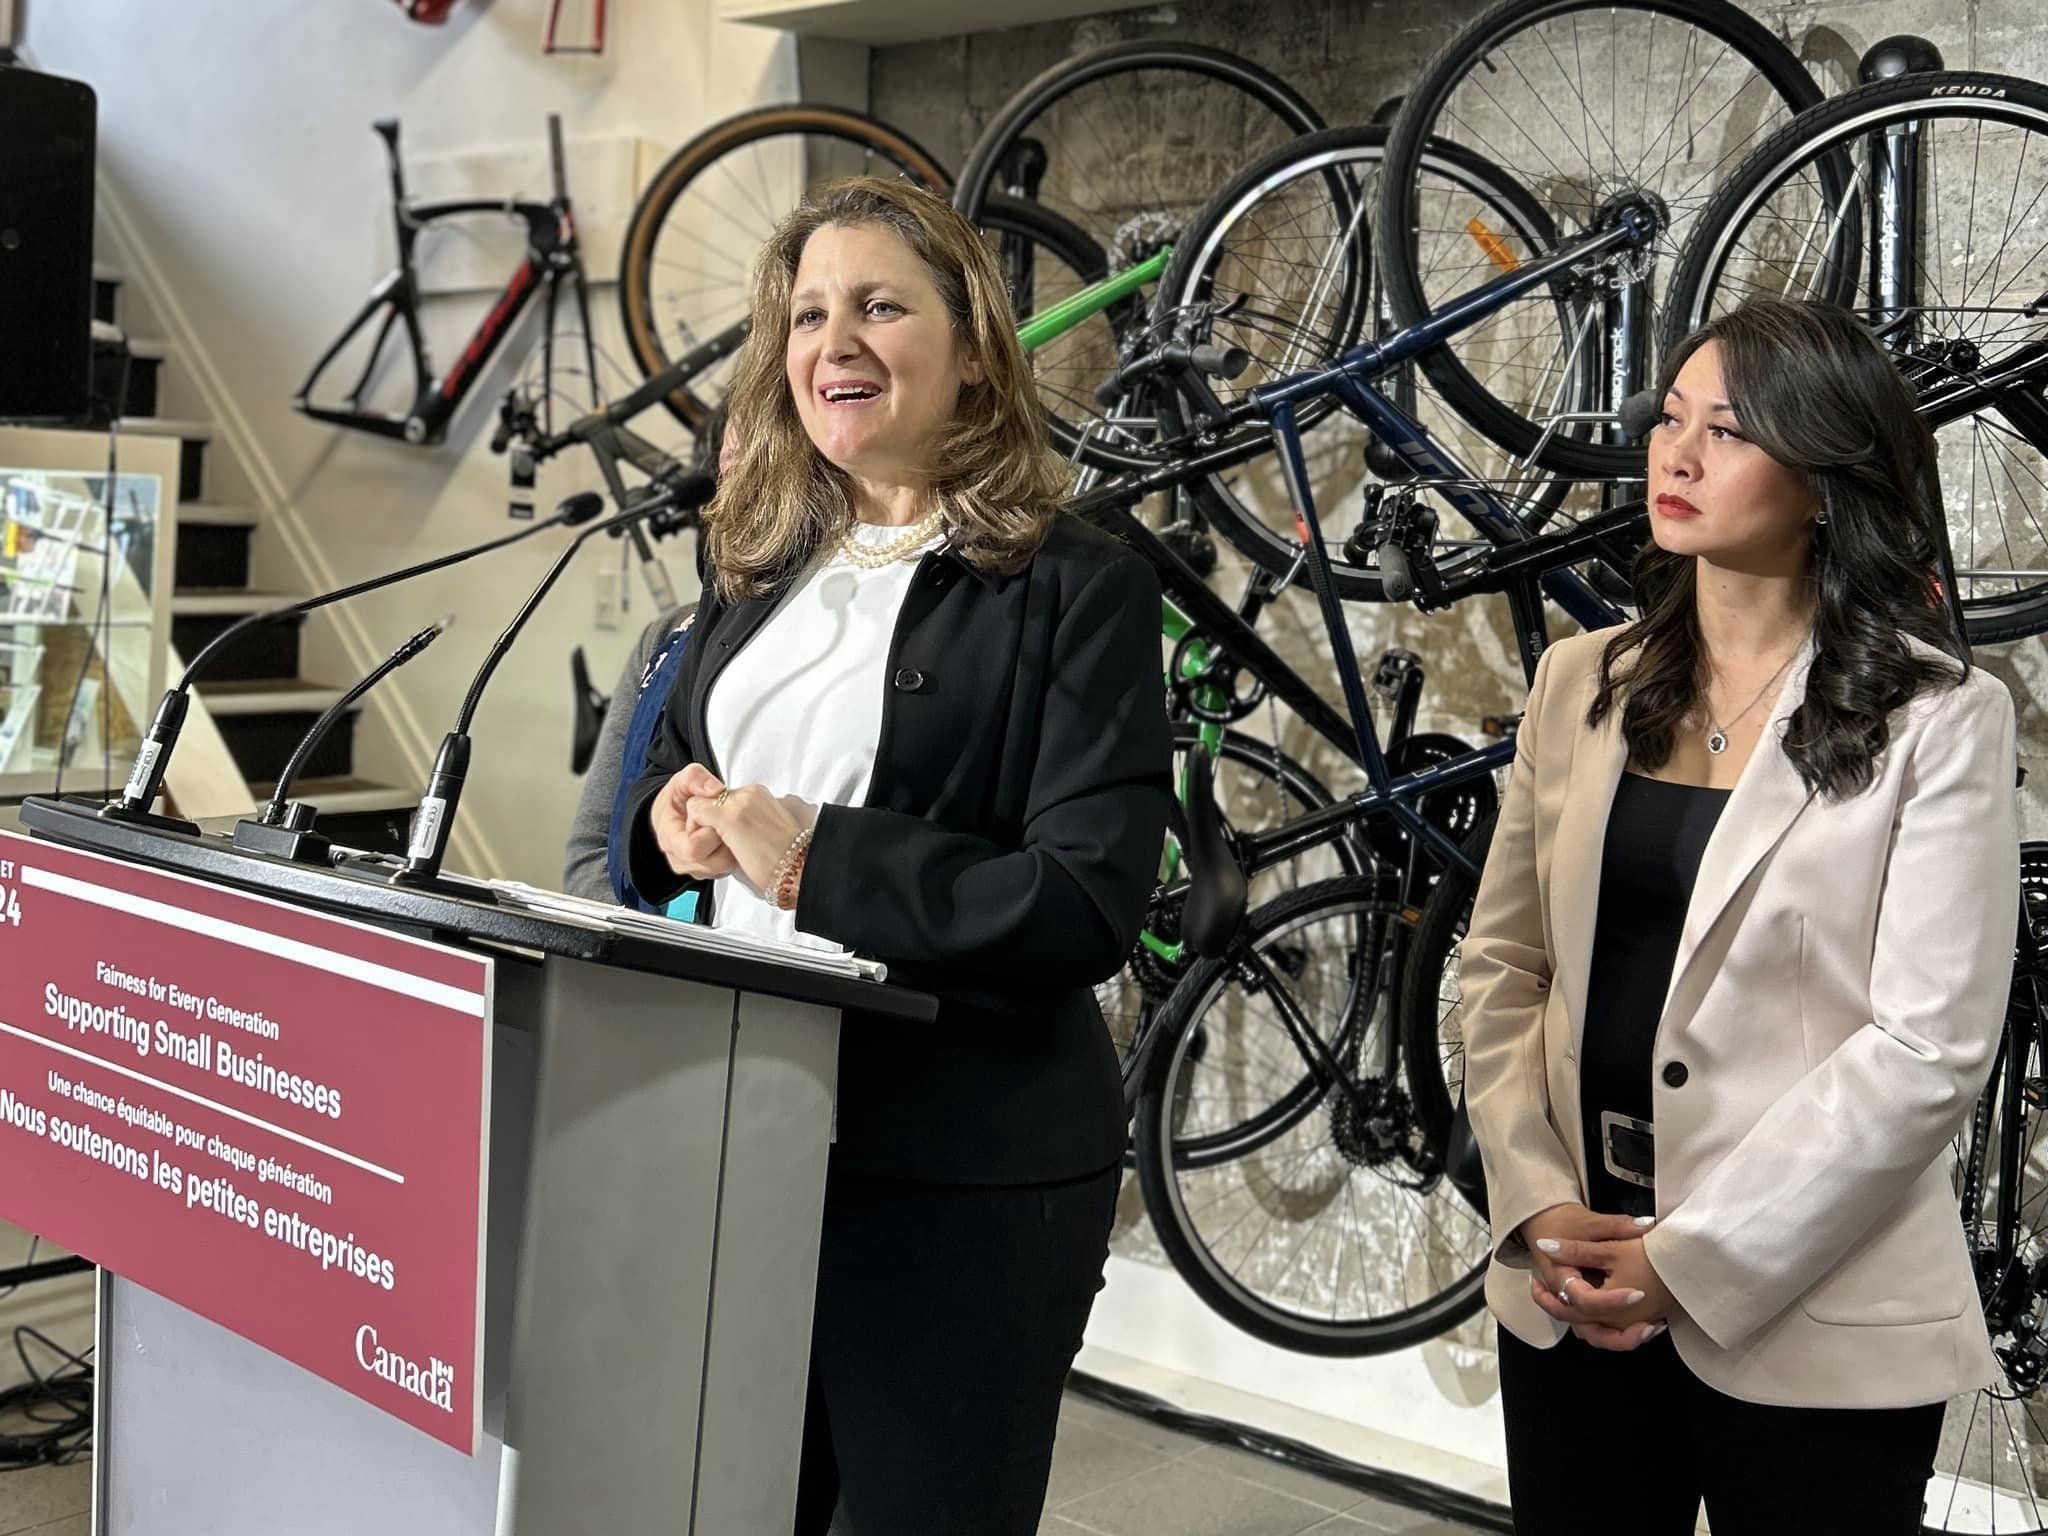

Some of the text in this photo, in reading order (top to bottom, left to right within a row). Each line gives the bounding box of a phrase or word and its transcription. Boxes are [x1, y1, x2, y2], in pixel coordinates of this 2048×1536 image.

[1930, 85, 2007, 98] KENDA
[44, 982, 342, 1119] Supporting Small Businesses
[96, 960, 280, 1041] Fairness for Every Generation
[0, 1089, 395, 1290] Nous soutenons les petites entreprises
[48, 1070, 332, 1205] Une chance équitable pour chaque génération
[355, 1324, 454, 1413] Canada
